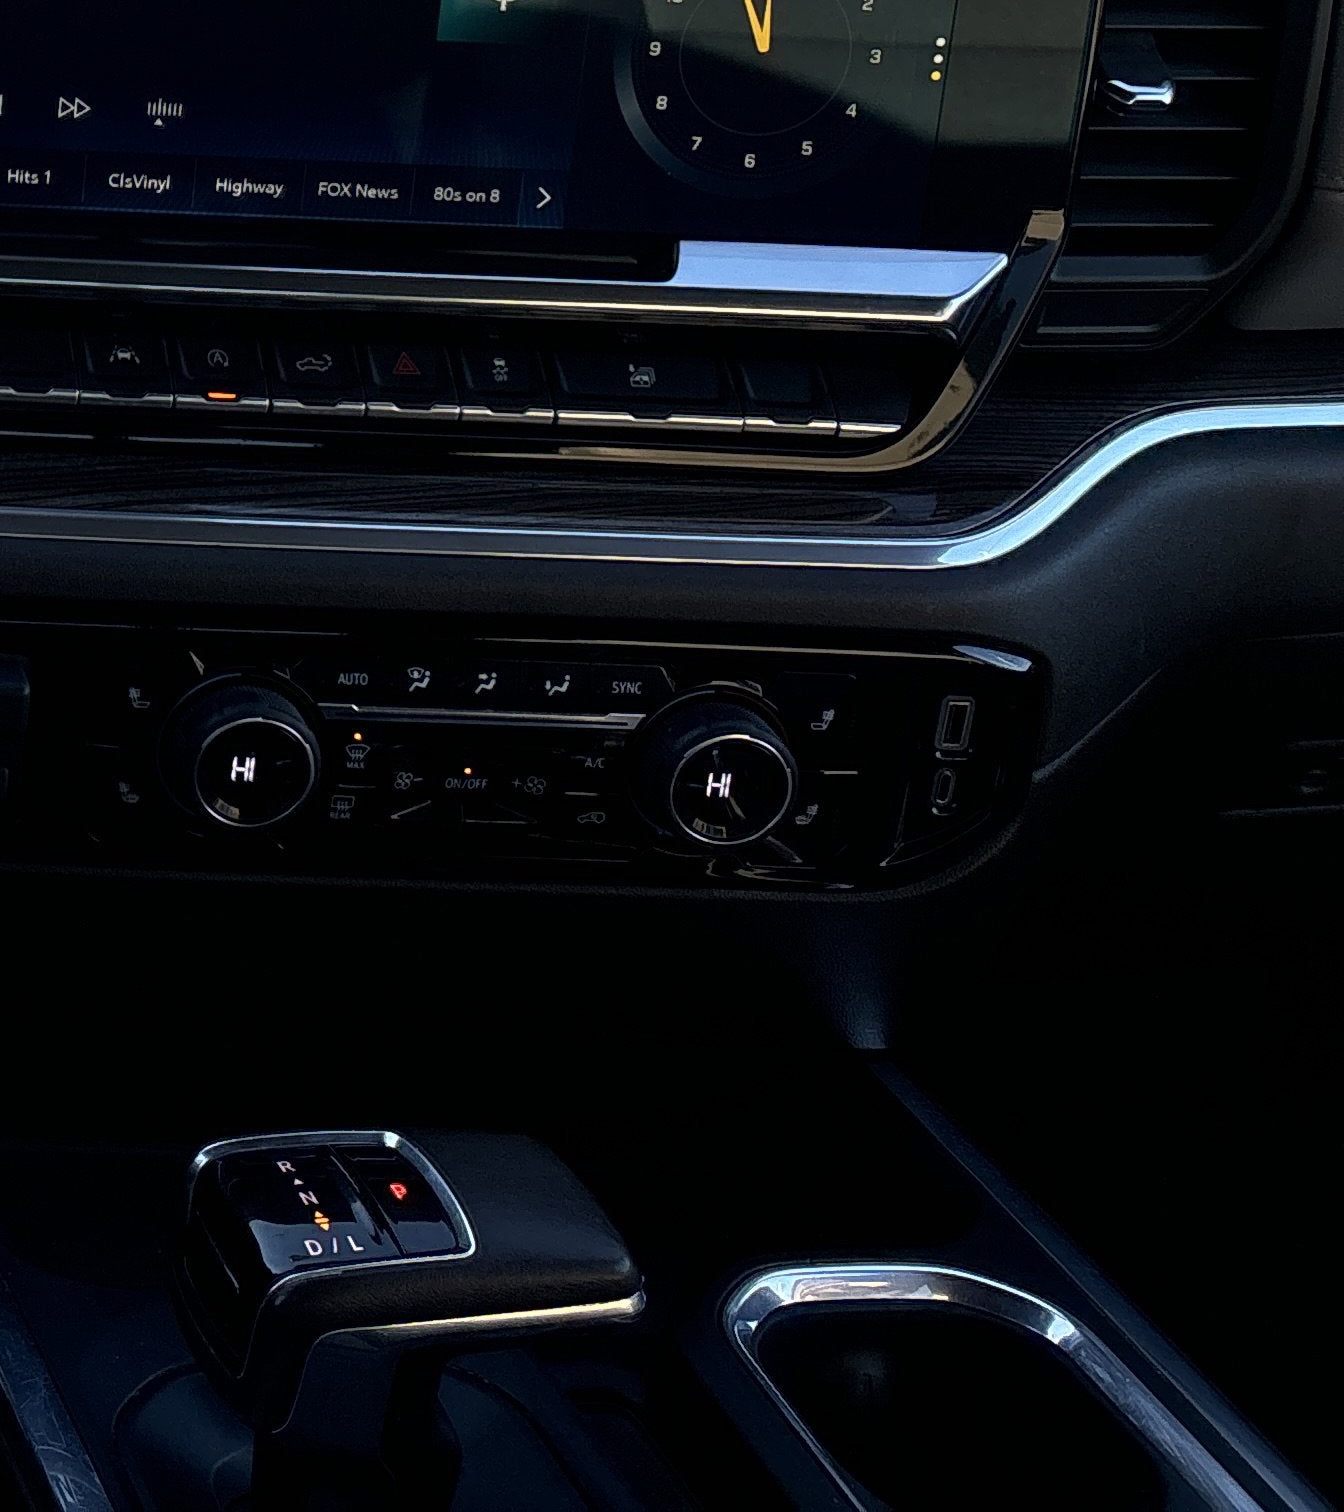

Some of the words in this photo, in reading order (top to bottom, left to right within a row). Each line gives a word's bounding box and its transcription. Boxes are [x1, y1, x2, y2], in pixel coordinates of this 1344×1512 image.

[648, 41, 662, 57] 9
[869, 49, 882, 64] 3
[655, 95, 668, 111] 8
[845, 103, 857, 118] 4
[691, 135, 703, 151] 7
[801, 140, 813, 156] 5
[744, 153, 756, 169] 6
[7, 168, 39, 185] Hits
[44, 170, 52, 185] 1
[108, 173, 171, 193] ClsVinyl
[215, 177, 284, 199] Highway
[317, 181, 352, 198] FOX
[355, 183, 399, 199] News
[433, 186, 462, 202] 80s
[465, 191, 486, 203] on
[489, 188, 500, 203] 8
[337, 672, 369, 686] AUTO
[611, 680, 642, 695] SYNC
[230, 756, 256, 782] HI
[585, 757, 605, 768] A/C
[444, 777, 489, 790] ON/OFF
[706, 772, 732, 798] HI
[276, 1160, 296, 1173] R
[298, 1190, 320, 1206] N
[389, 1182, 408, 1200] P
